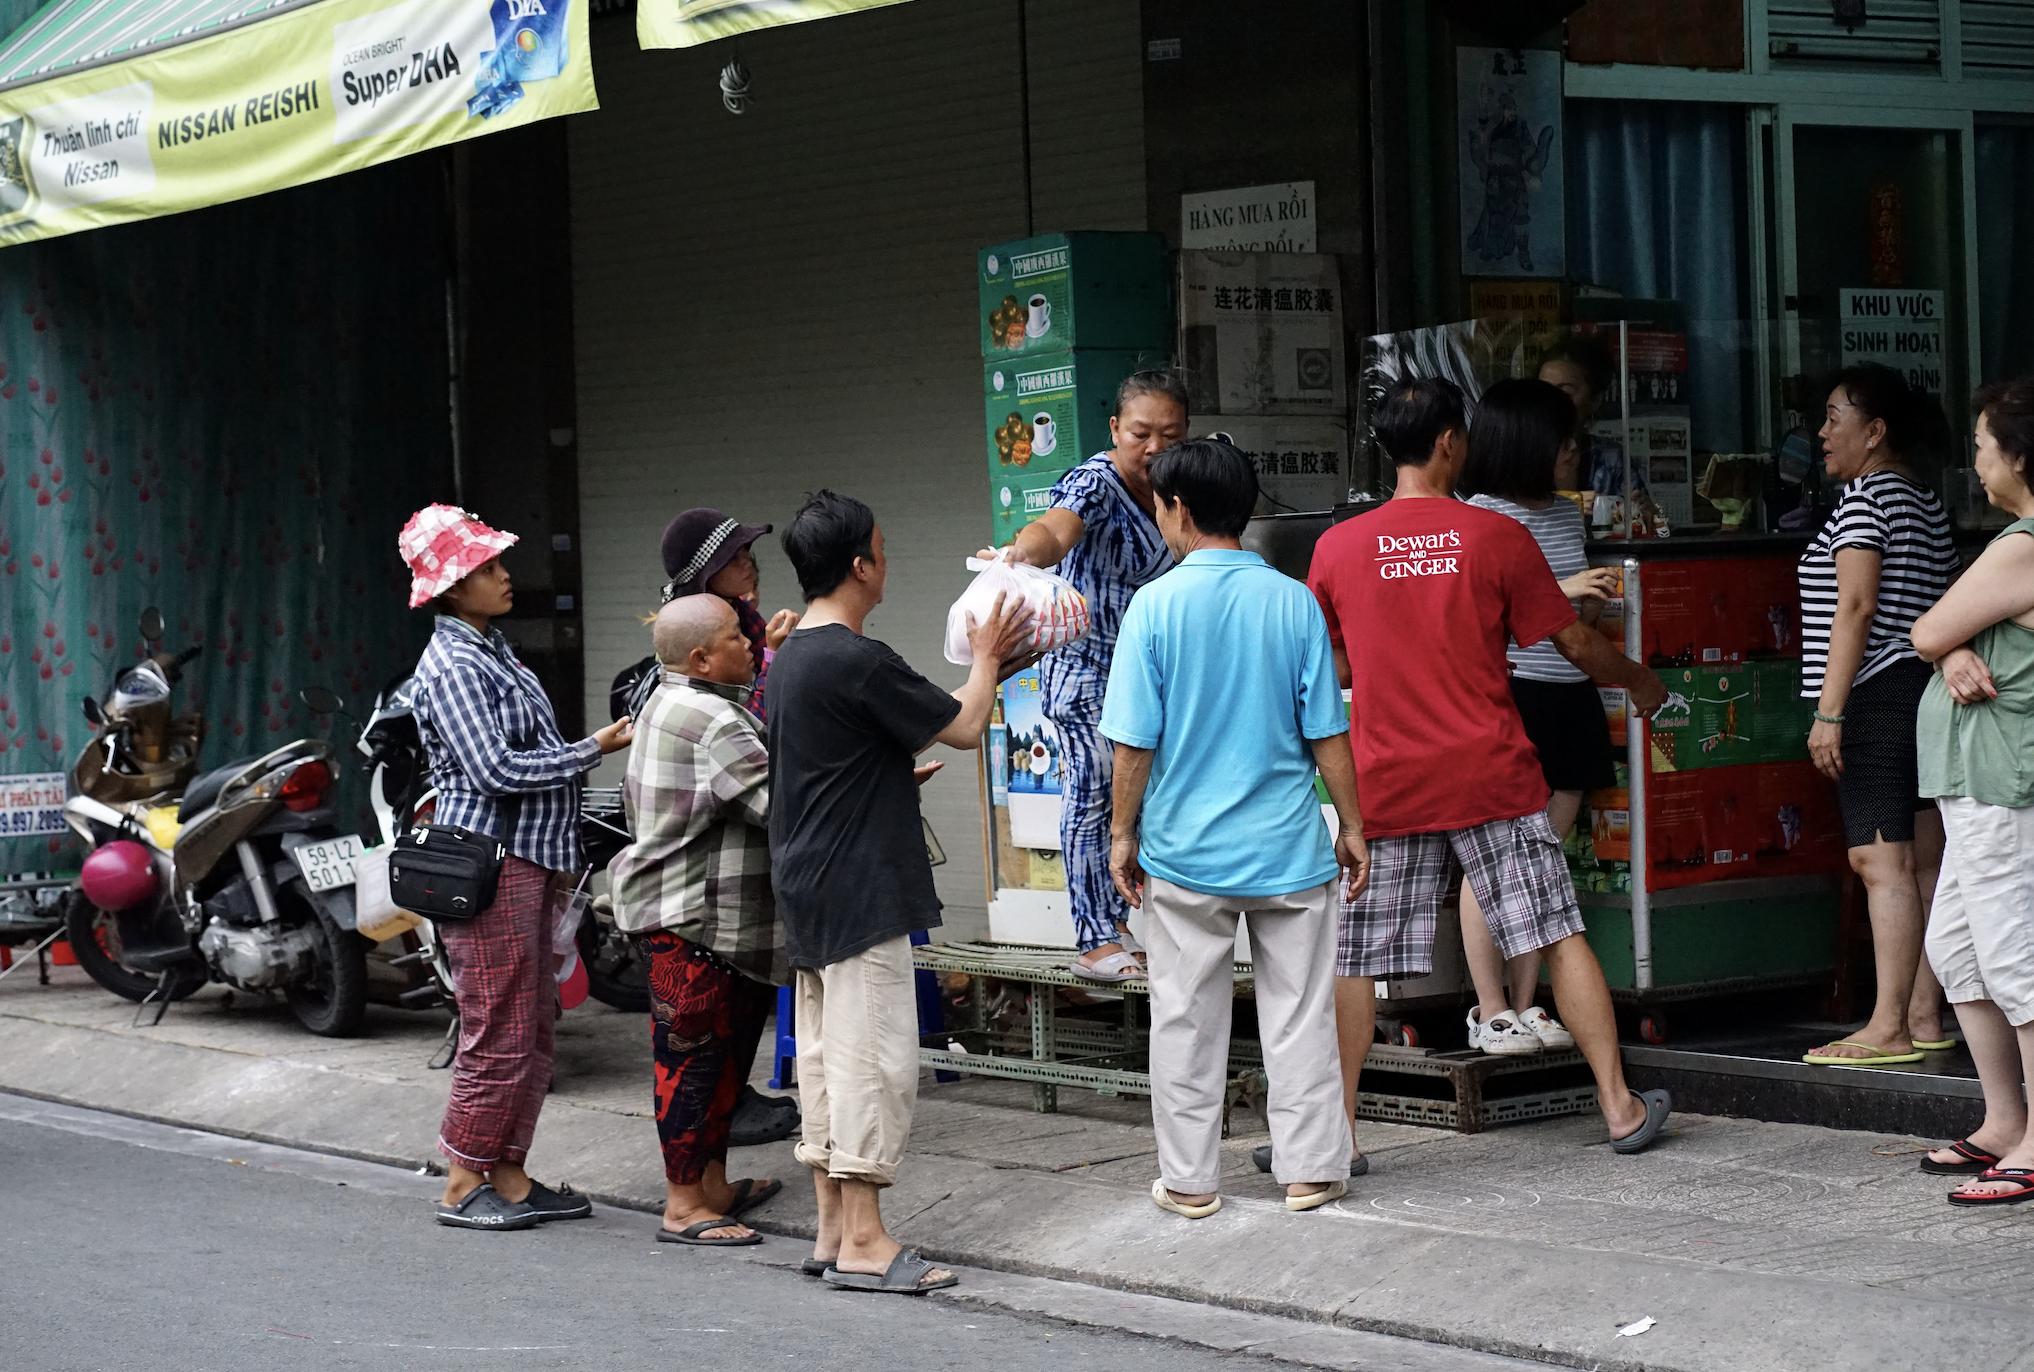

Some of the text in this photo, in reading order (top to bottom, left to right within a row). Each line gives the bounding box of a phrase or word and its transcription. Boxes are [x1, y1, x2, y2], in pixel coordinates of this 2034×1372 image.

[343, 37, 404, 66] OCEAN BRIGHT
[159, 80, 319, 149] NISSAN REISHI
[85, 117, 112, 148] linh
[116, 110, 141, 139] chi
[64, 159, 119, 187] Nissan
[1189, 188, 1308, 231] HÀNG MUA RỒI
[1214, 285, 1334, 312] 连花清瘟胶囊
[1511, 294, 1535, 310] MUA
[1852, 293, 1934, 321] KHU VỰC
[1844, 331, 1888, 352] SINH
[1377, 529, 1461, 554] Dewar's
[1409, 550, 1427, 559] AND
[1380, 557, 1460, 580] GINGER
[471, 1214, 505, 1225] crocs
